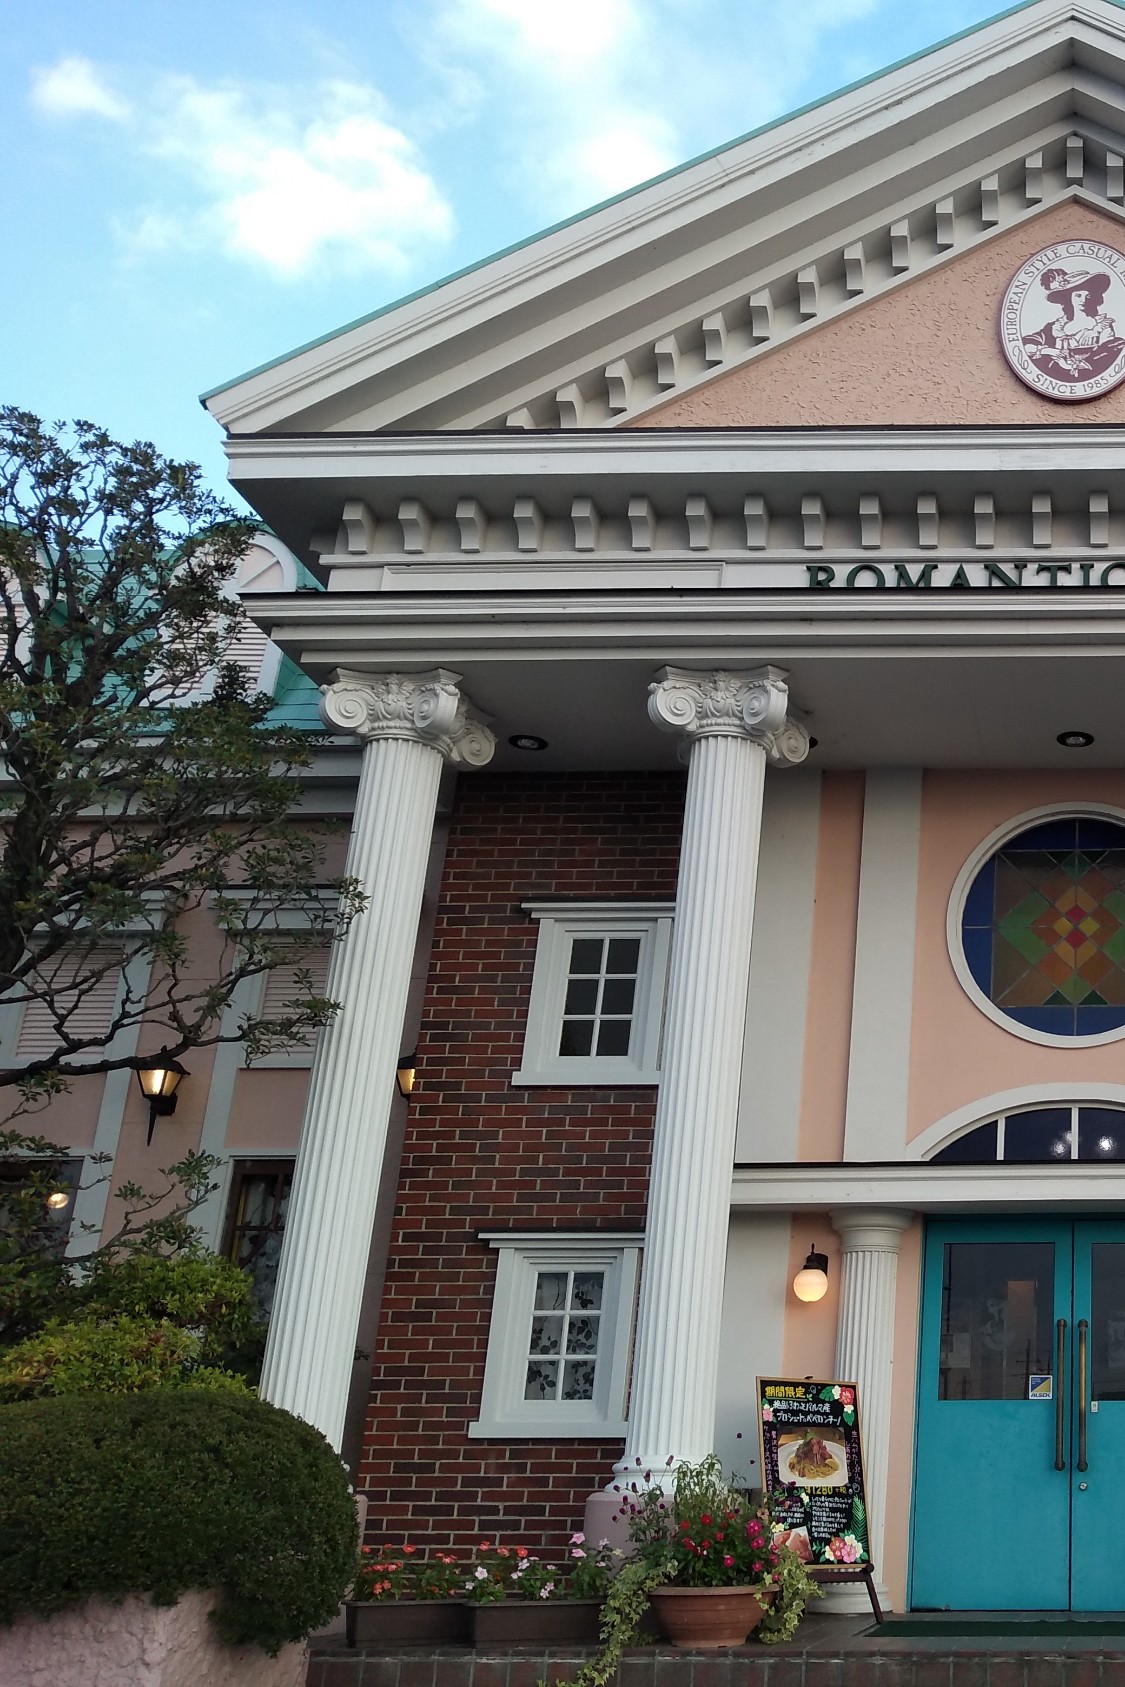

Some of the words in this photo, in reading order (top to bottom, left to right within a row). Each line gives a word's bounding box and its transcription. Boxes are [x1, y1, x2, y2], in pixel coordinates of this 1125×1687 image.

[1004, 280, 1029, 344] EUROPEAN
[1024, 248, 1062, 278] STYLE
[1066, 244, 1120, 269] CASUAL
[1031, 373, 1078, 395] SINCE
[1082, 376, 1110, 393] 1985
[765, 1385, 806, 1398] 期間限定
